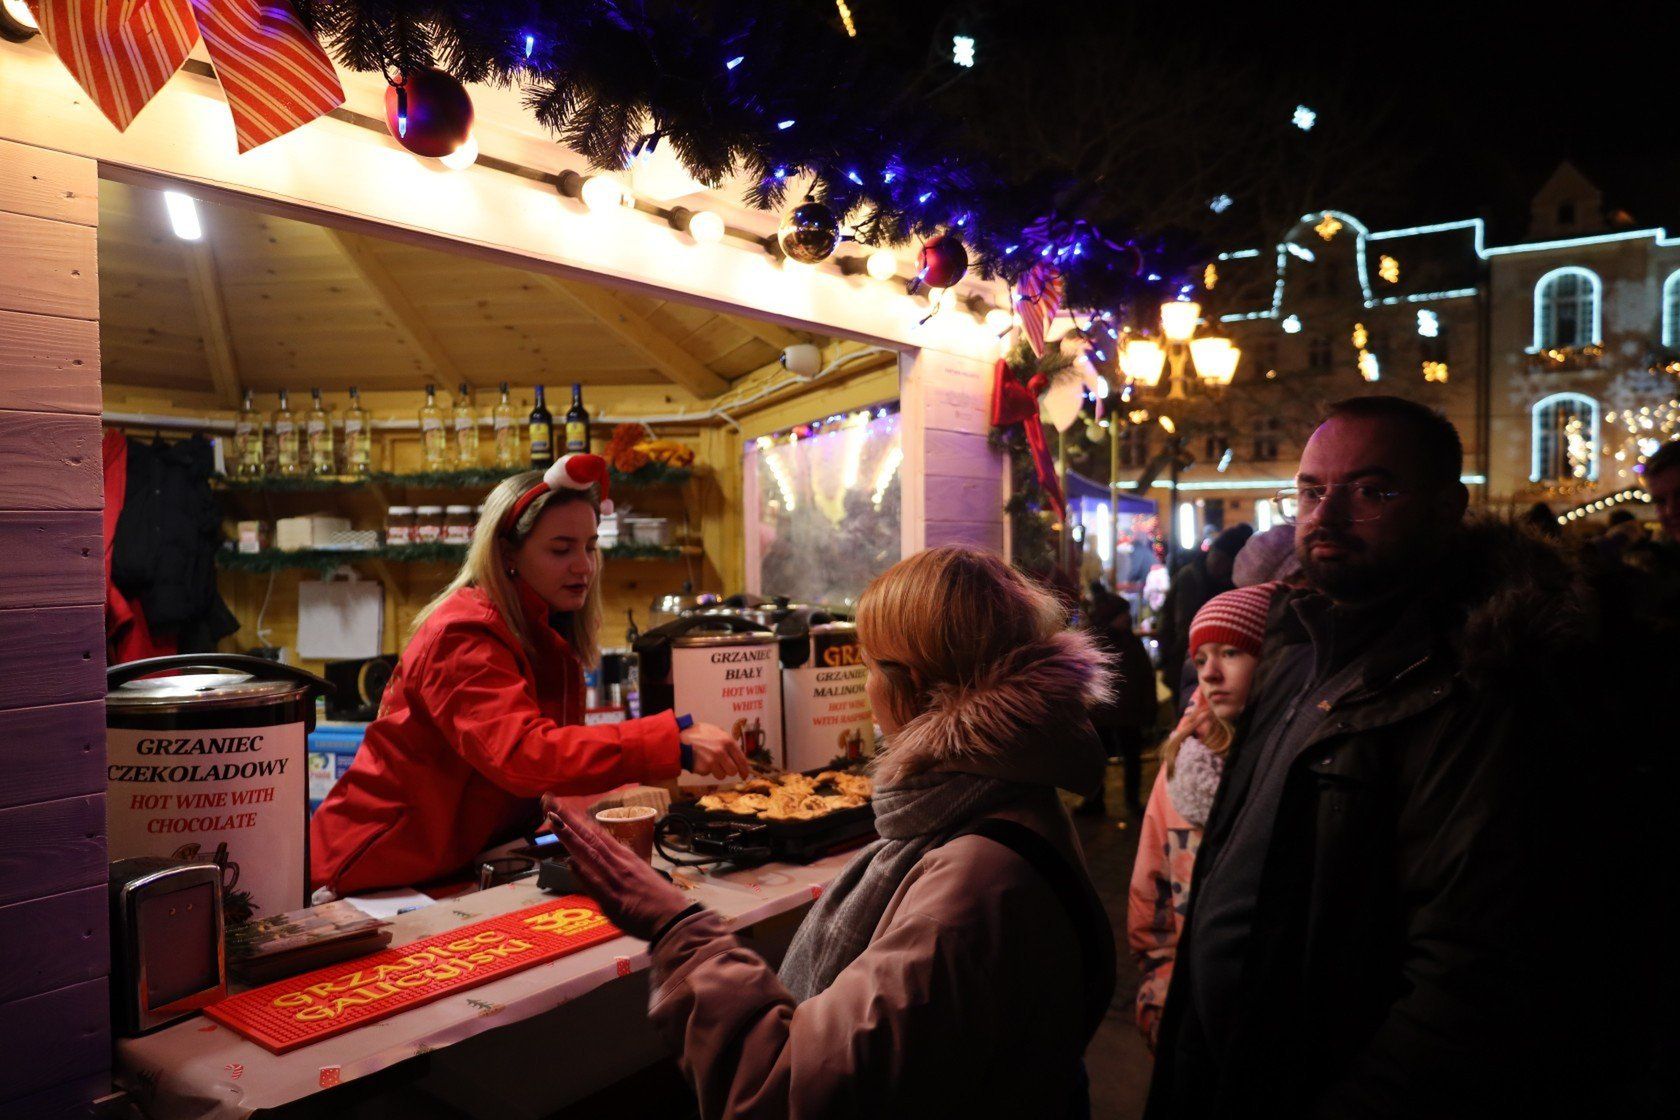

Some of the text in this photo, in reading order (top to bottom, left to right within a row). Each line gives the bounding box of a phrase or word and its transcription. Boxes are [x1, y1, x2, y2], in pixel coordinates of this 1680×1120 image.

[711, 649, 771, 664] GRZANIEC
[725, 667, 763, 680] BIAŁY
[721, 686, 745, 698] HOT
[732, 699, 763, 712] WHITE
[136, 735, 264, 756] GRZANIEC
[107, 758, 289, 783] CZEKOLADOWY
[130, 787, 276, 810] HOT WINE WITH
[147, 812, 258, 834] CHOCOLATE
[271, 929, 507, 1008] GRZANIEC
